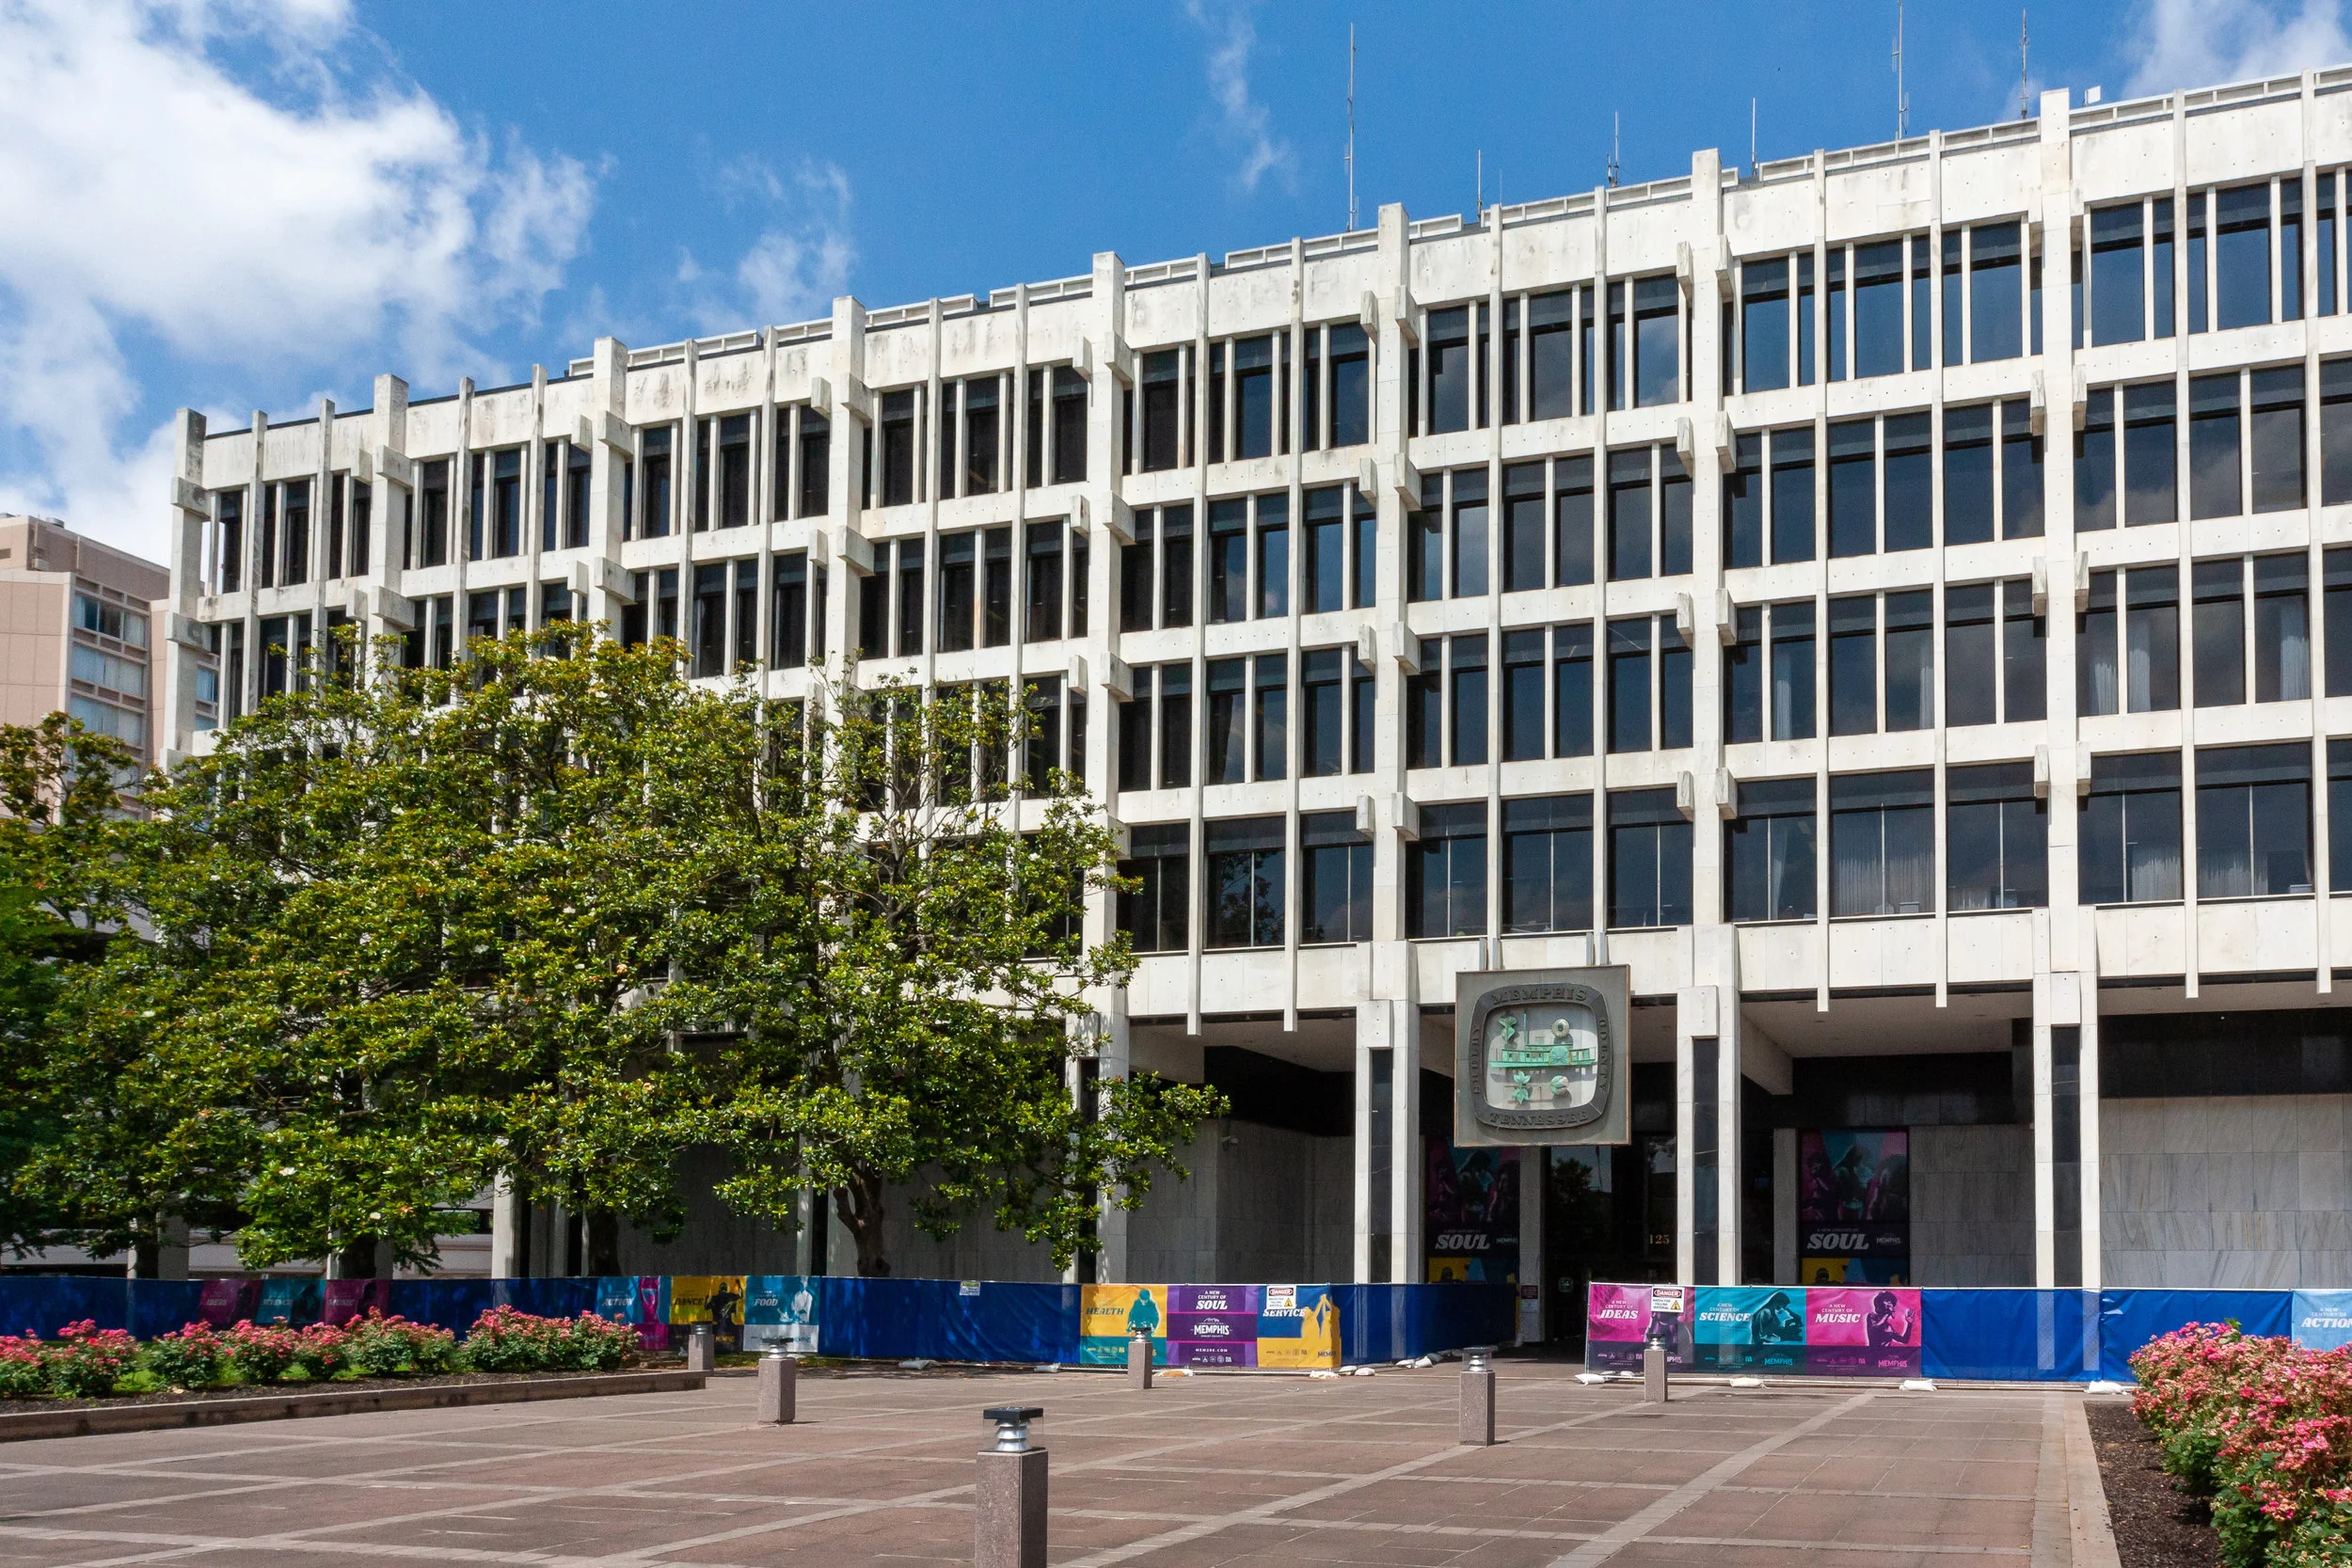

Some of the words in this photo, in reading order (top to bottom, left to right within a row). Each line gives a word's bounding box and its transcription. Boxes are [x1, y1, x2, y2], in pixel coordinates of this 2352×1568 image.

[1491, 989, 1587, 1006] MEMPHIS
[1489, 1111, 1589, 1126] TENNESSEE
[1435, 1234, 1490, 1250] SOUL
[1649, 1234, 1670, 1244] 125
[1806, 1233, 1869, 1250] SOUL
[754, 1298, 778, 1307] FOOD
[1196, 1300, 1228, 1310] SOUL
[1086, 1307, 1124, 1316] HEALTH
[1263, 1308, 1307, 1317] SERVICE
[1599, 1309, 1639, 1320] IDEAS
[1699, 1312, 1752, 1322] SCIENCE
[1815, 1313, 1861, 1323] MUSIC
[1194, 1324, 1230, 1336] MEMPHIS
[1764, 1357, 1793, 1366] MEMPHIS
